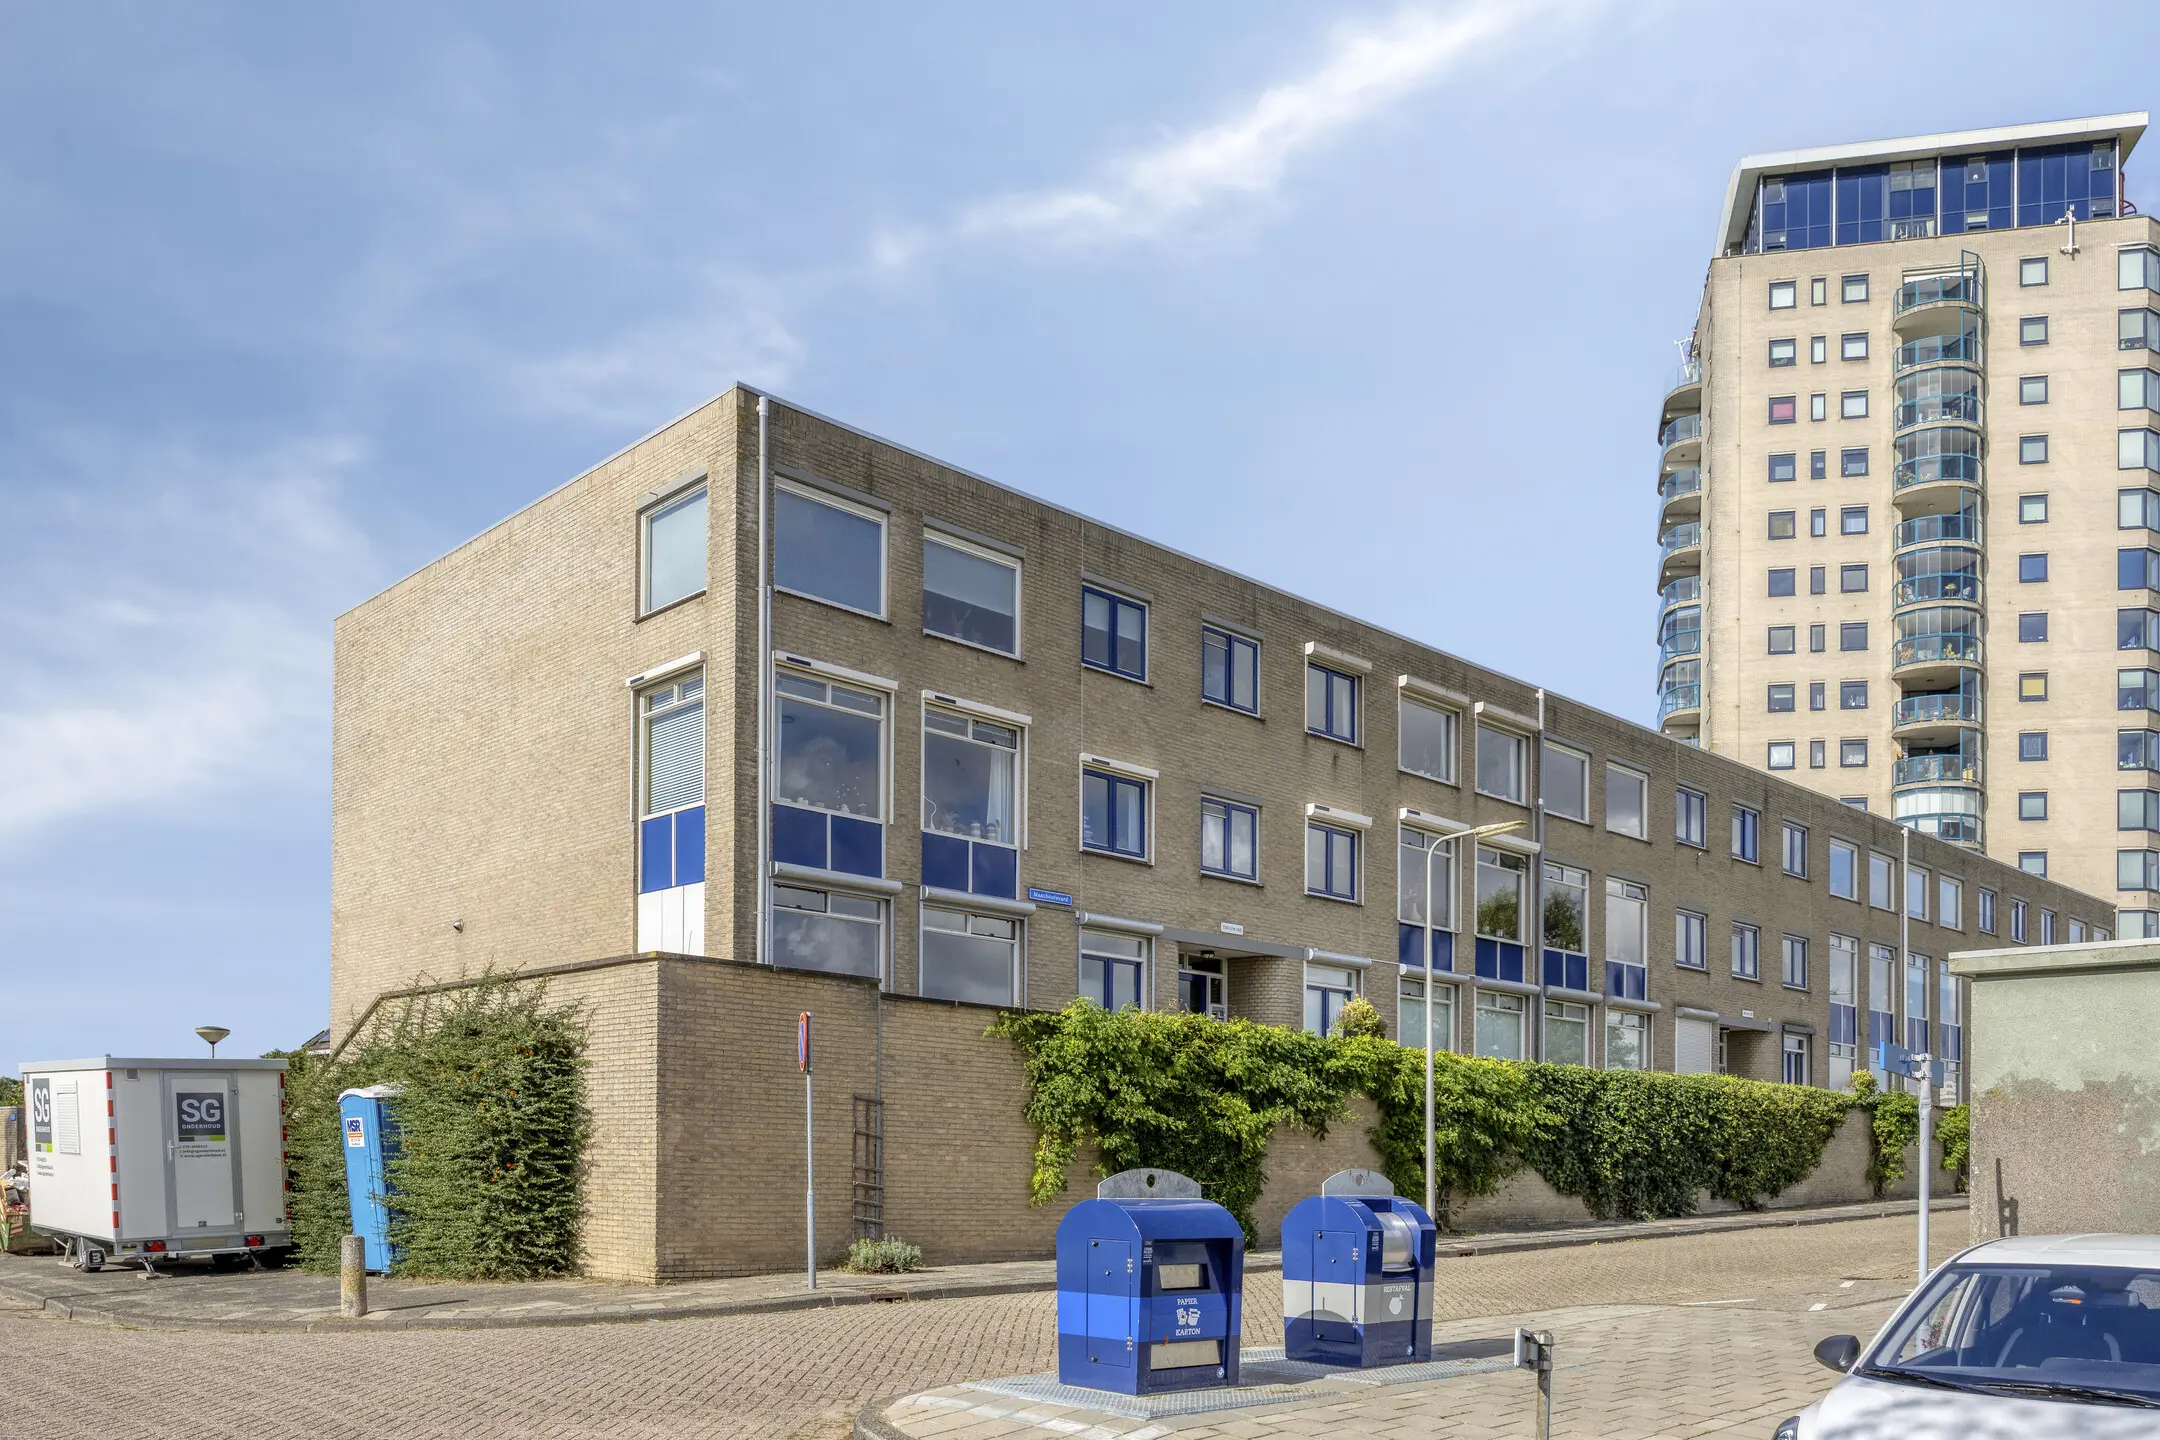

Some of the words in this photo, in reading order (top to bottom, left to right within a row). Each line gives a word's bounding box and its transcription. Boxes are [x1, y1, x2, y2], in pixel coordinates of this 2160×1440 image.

[1033, 891, 1069, 903] Maasboulevard
[34, 1087, 50, 1122] SG
[181, 1098, 221, 1122] SG
[1383, 1284, 1411, 1293] RESTAFVAL
[1175, 1328, 1201, 1336] KARTON
